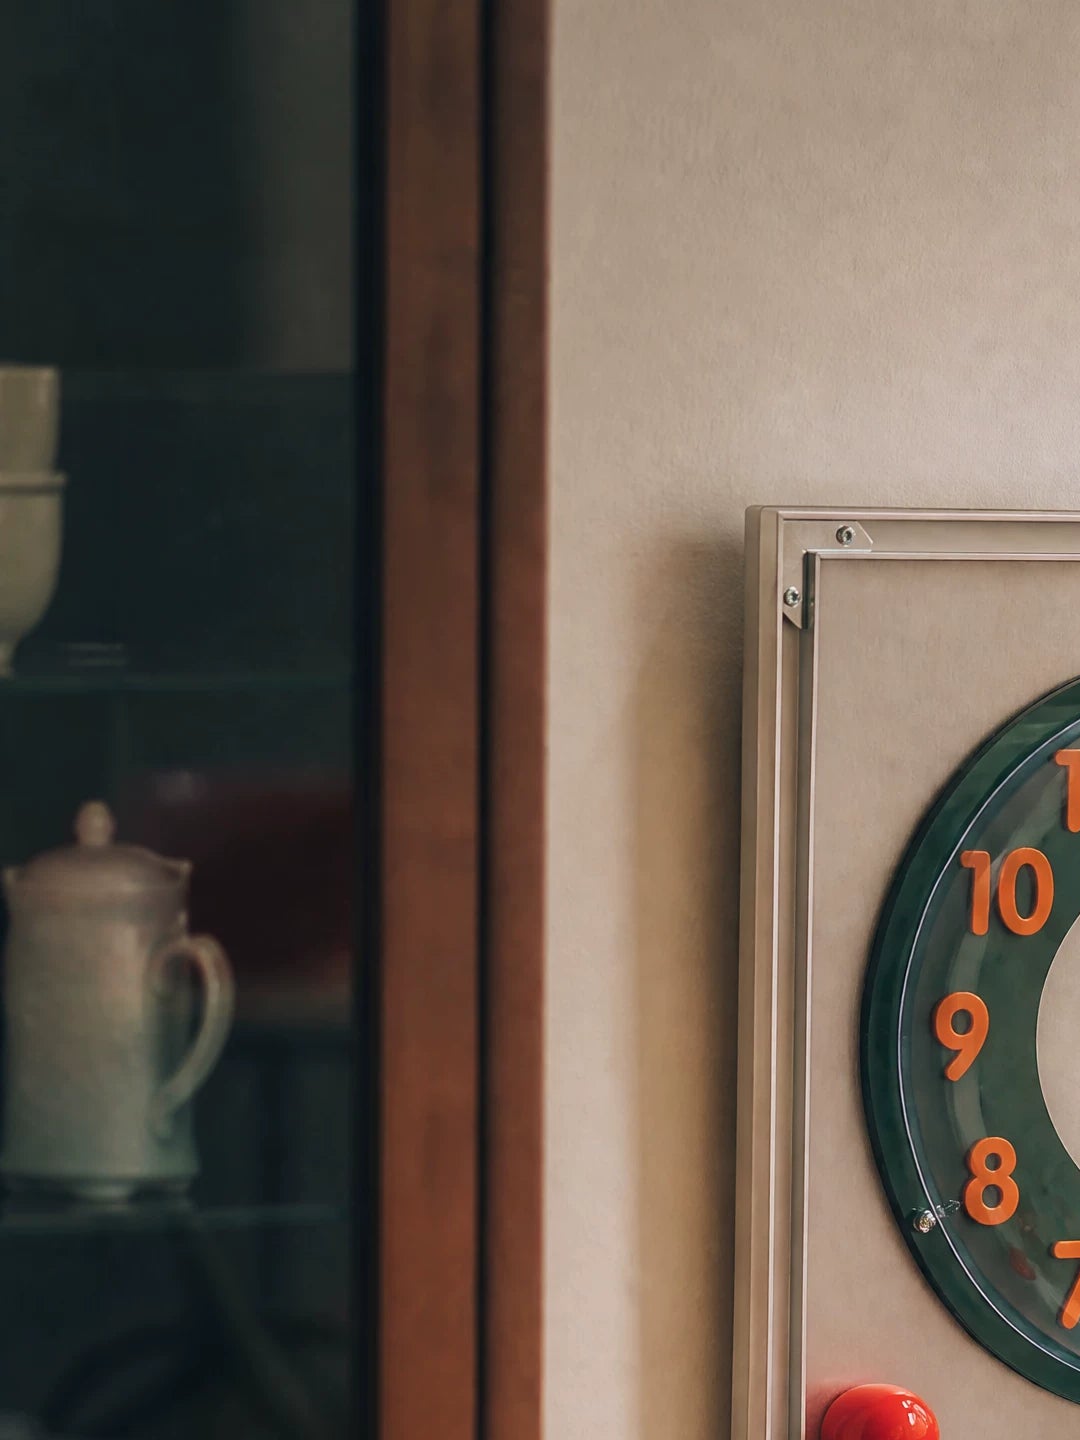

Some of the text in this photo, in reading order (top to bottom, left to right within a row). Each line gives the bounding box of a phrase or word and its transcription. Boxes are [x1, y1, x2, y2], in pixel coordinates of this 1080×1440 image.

[962, 847, 1054, 936] 10
[934, 992, 990, 1081] 9
[965, 1137, 1019, 1226] 8
